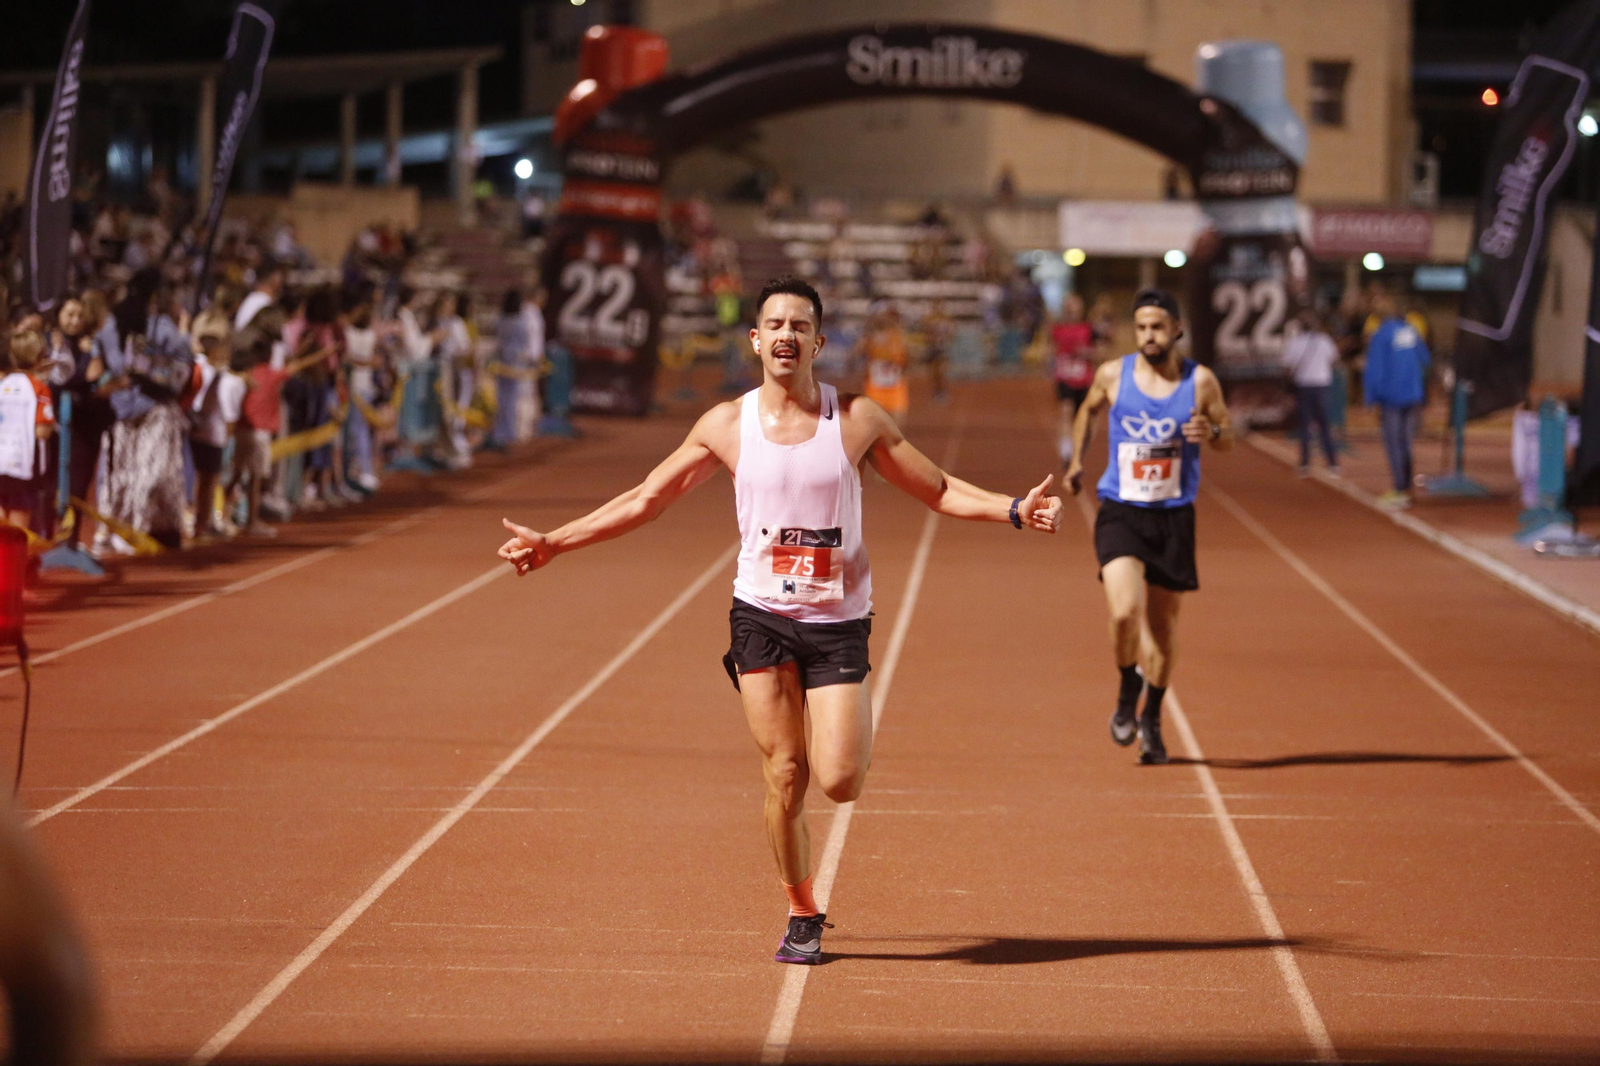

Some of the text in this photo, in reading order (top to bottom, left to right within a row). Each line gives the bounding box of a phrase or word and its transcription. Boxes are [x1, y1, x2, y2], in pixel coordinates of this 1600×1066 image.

[846, 35, 1025, 88] Smilke
[1479, 136, 1548, 258] Smilke
[784, 530, 802, 545] 21
[789, 555, 814, 576] 75
